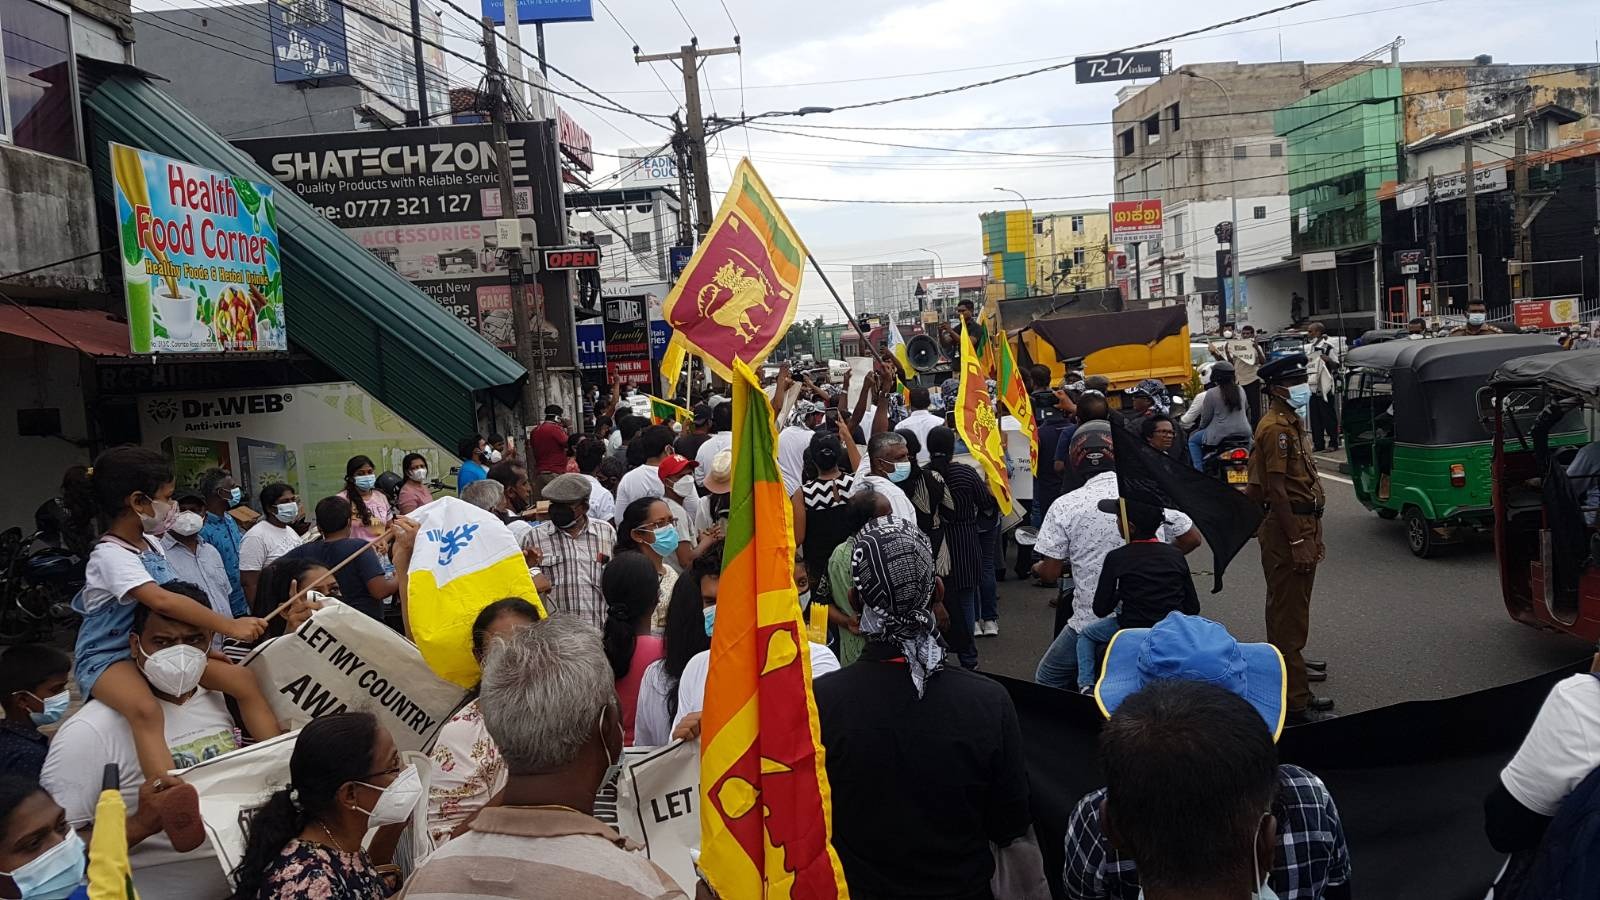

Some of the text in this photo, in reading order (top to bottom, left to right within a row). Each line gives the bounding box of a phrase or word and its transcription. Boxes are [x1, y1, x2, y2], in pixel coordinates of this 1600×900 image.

[271, 144, 427, 183] SHATECH
[645, 167, 676, 179] TOUC
[168, 163, 239, 218] Health
[297, 172, 500, 197] Quality Products with Reliable Servic
[344, 198, 391, 219] 0777
[396, 197, 430, 216] 321
[437, 194, 472, 213] 127
[135, 204, 269, 266] Food Corner
[361, 224, 482, 247] ACCESSORIES
[145, 258, 181, 280] Healthy
[184, 263, 209, 281] Foods
[550, 252, 596, 268] OPEN
[417, 283, 443, 295] rand
[446, 282, 471, 294] New
[602, 286, 631, 296] SALO
[480, 293, 510, 308] GAME
[651, 337, 666, 346] ries
[185, 420, 242, 432] Anti-virus
[297, 619, 436, 736] LET MY COUNTRY
[650, 786, 693, 824] LET
